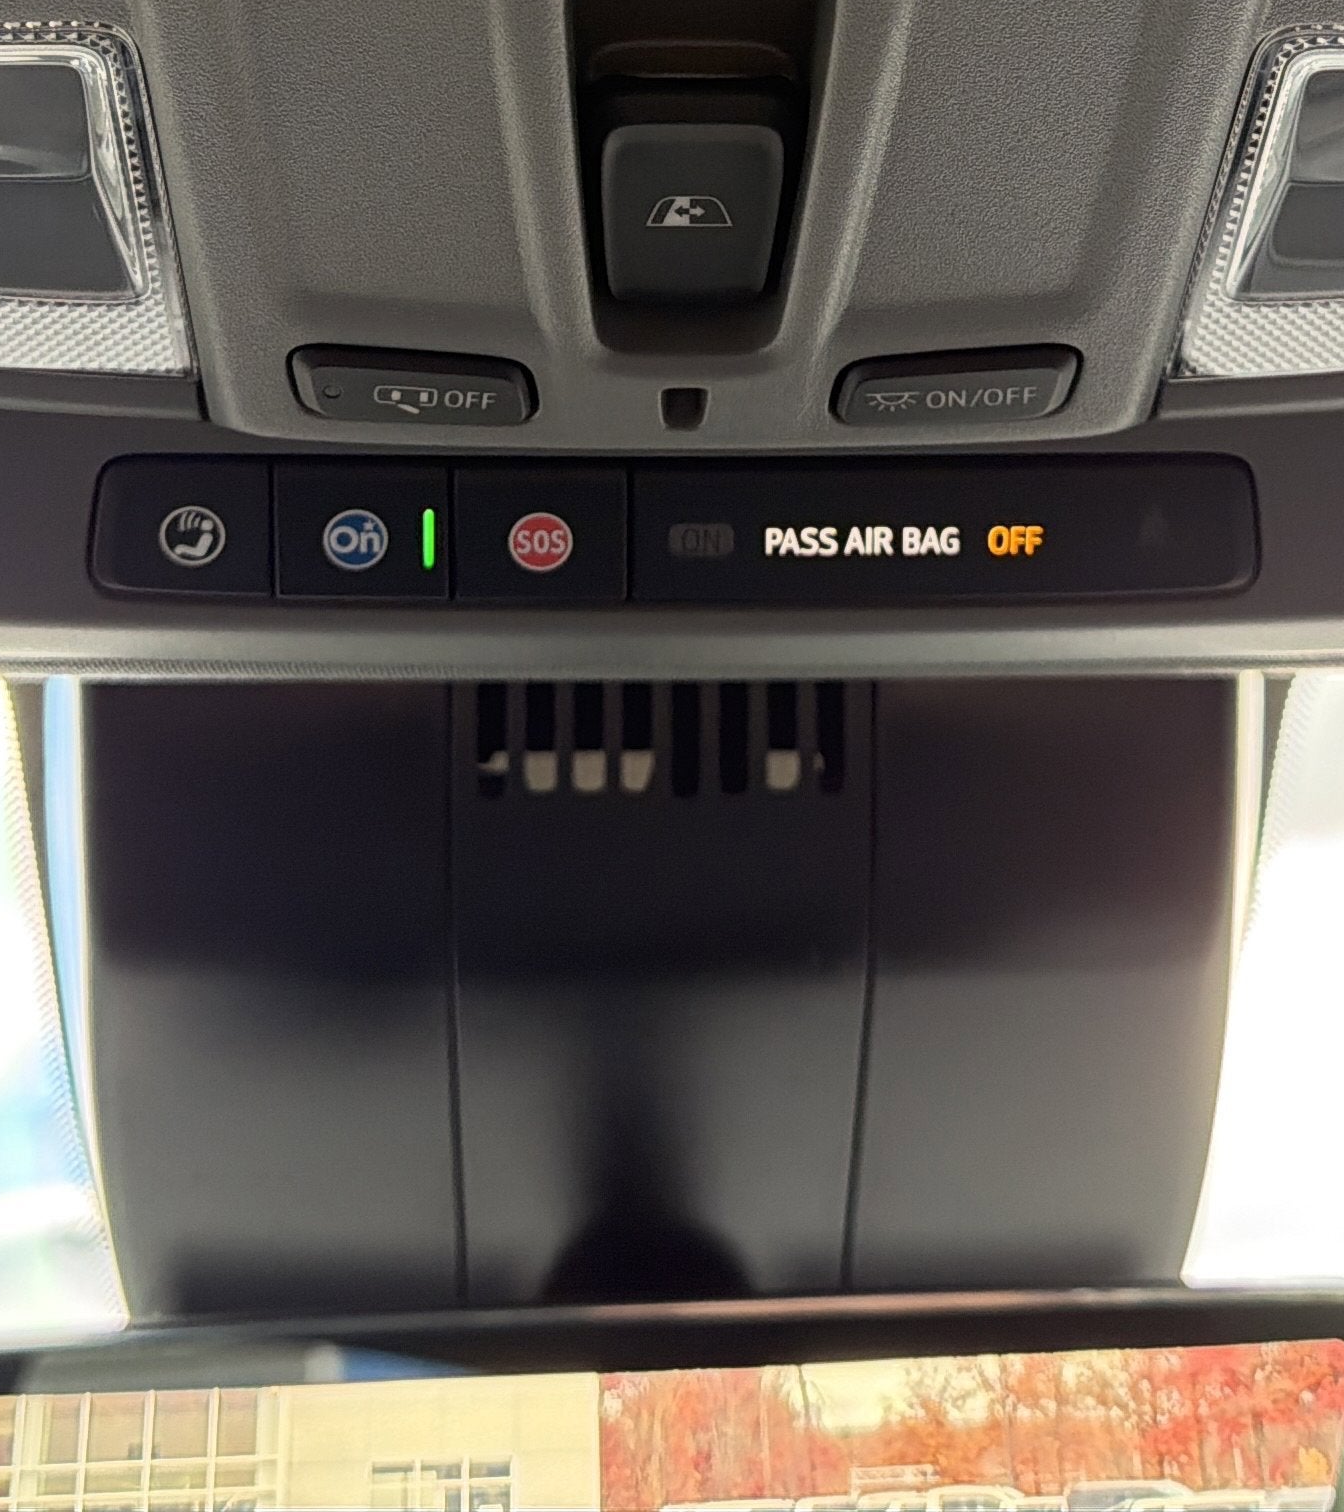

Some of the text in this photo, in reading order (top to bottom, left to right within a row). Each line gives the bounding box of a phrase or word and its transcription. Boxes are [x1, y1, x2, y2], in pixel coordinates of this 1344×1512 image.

[444, 390, 496, 410] OFF
[926, 385, 1038, 410] ON/OFF
[329, 520, 382, 554] On
[517, 528, 564, 557] SOS
[680, 525, 1043, 556] ON PASS AIR BAG OFF
